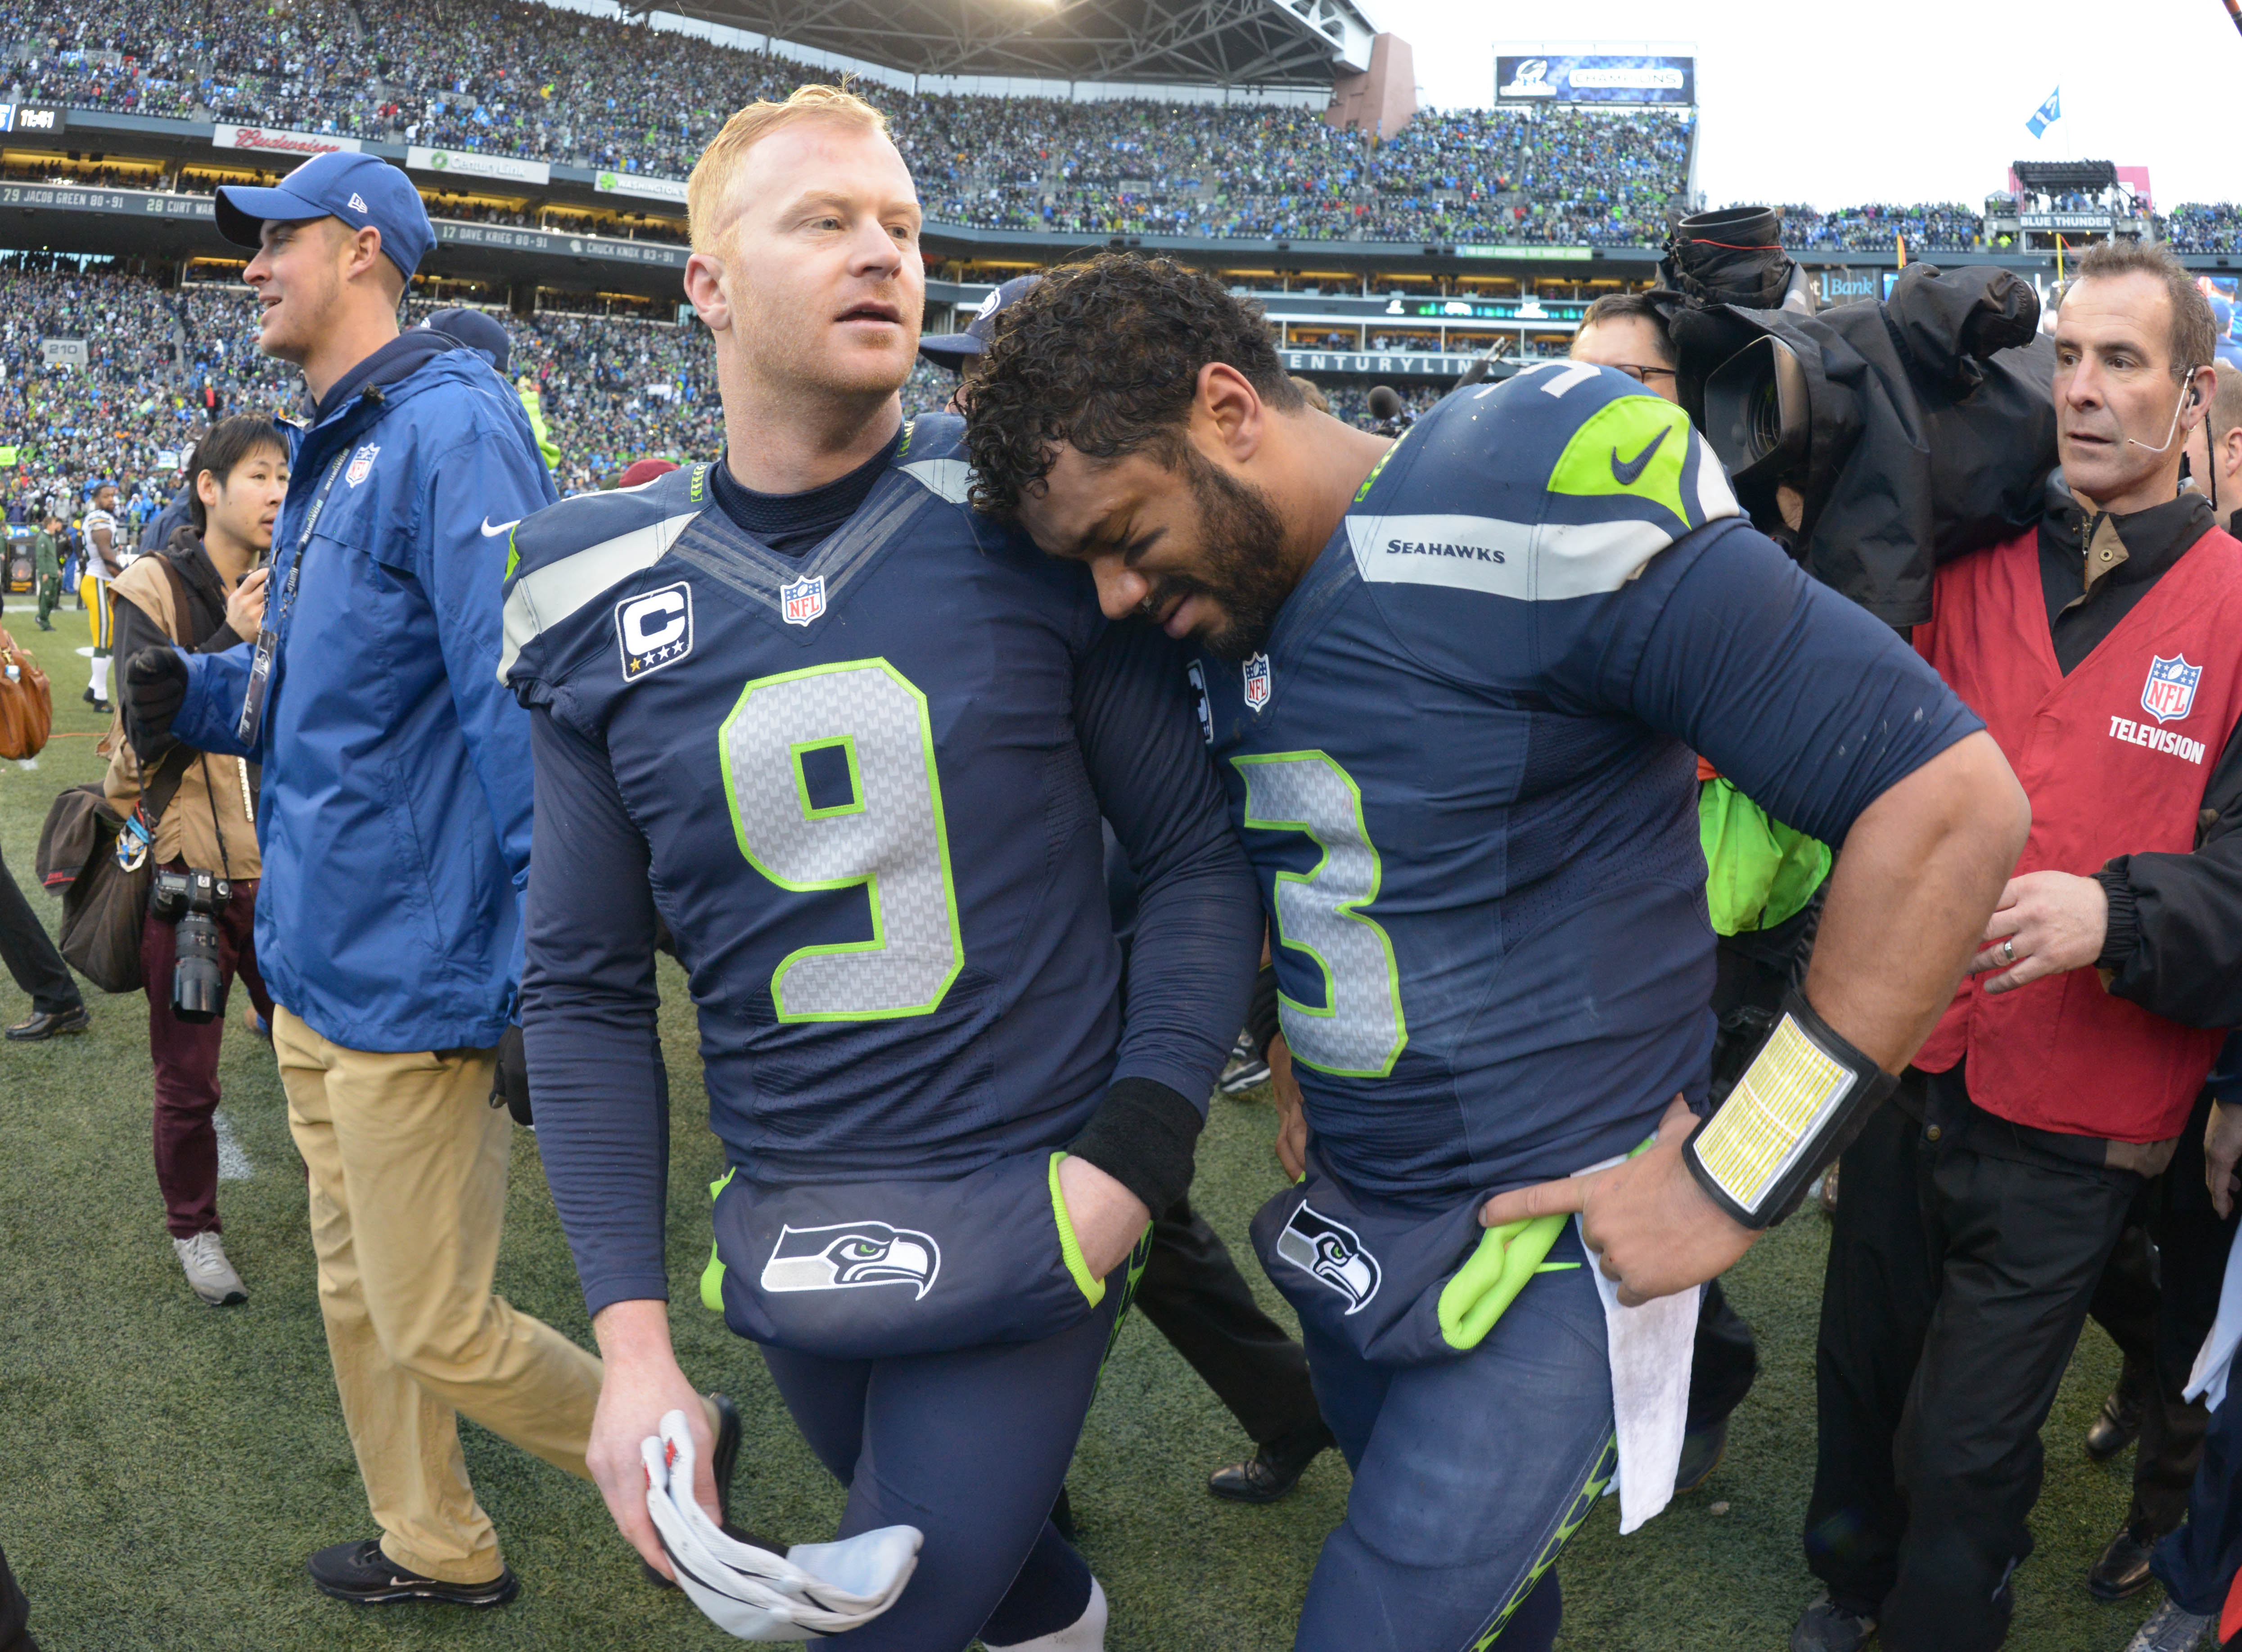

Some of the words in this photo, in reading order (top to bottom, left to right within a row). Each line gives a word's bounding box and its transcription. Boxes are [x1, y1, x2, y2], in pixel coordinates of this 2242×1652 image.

[235, 128, 340, 152] Budweiser
[3, 188, 20, 202] 79
[23, 190, 53, 203] JACOB
[56, 192, 87, 206] GREEN
[146, 198, 163, 212] 28
[167, 201, 192, 214] CURT
[2020, 216, 2052, 226] BLUE
[2054, 217, 2111, 226] THUNDER
[442, 226, 456, 238] 17
[459, 228, 482, 241] DAVE
[485, 230, 512, 244] KRIEG
[586, 242, 615, 255] CHUCK
[1831, 276, 1873, 296] Bank
[49, 344, 77, 355] 210
[789, 596, 819, 618] NFL
[623, 591, 685, 655] C
[1249, 677, 1266, 700] NFL
[2147, 680, 2185, 713] NFL
[2109, 715, 2206, 765] TELEVISION
[719, 657, 965, 1024] 9
[1229, 749, 1408, 1078] 3
